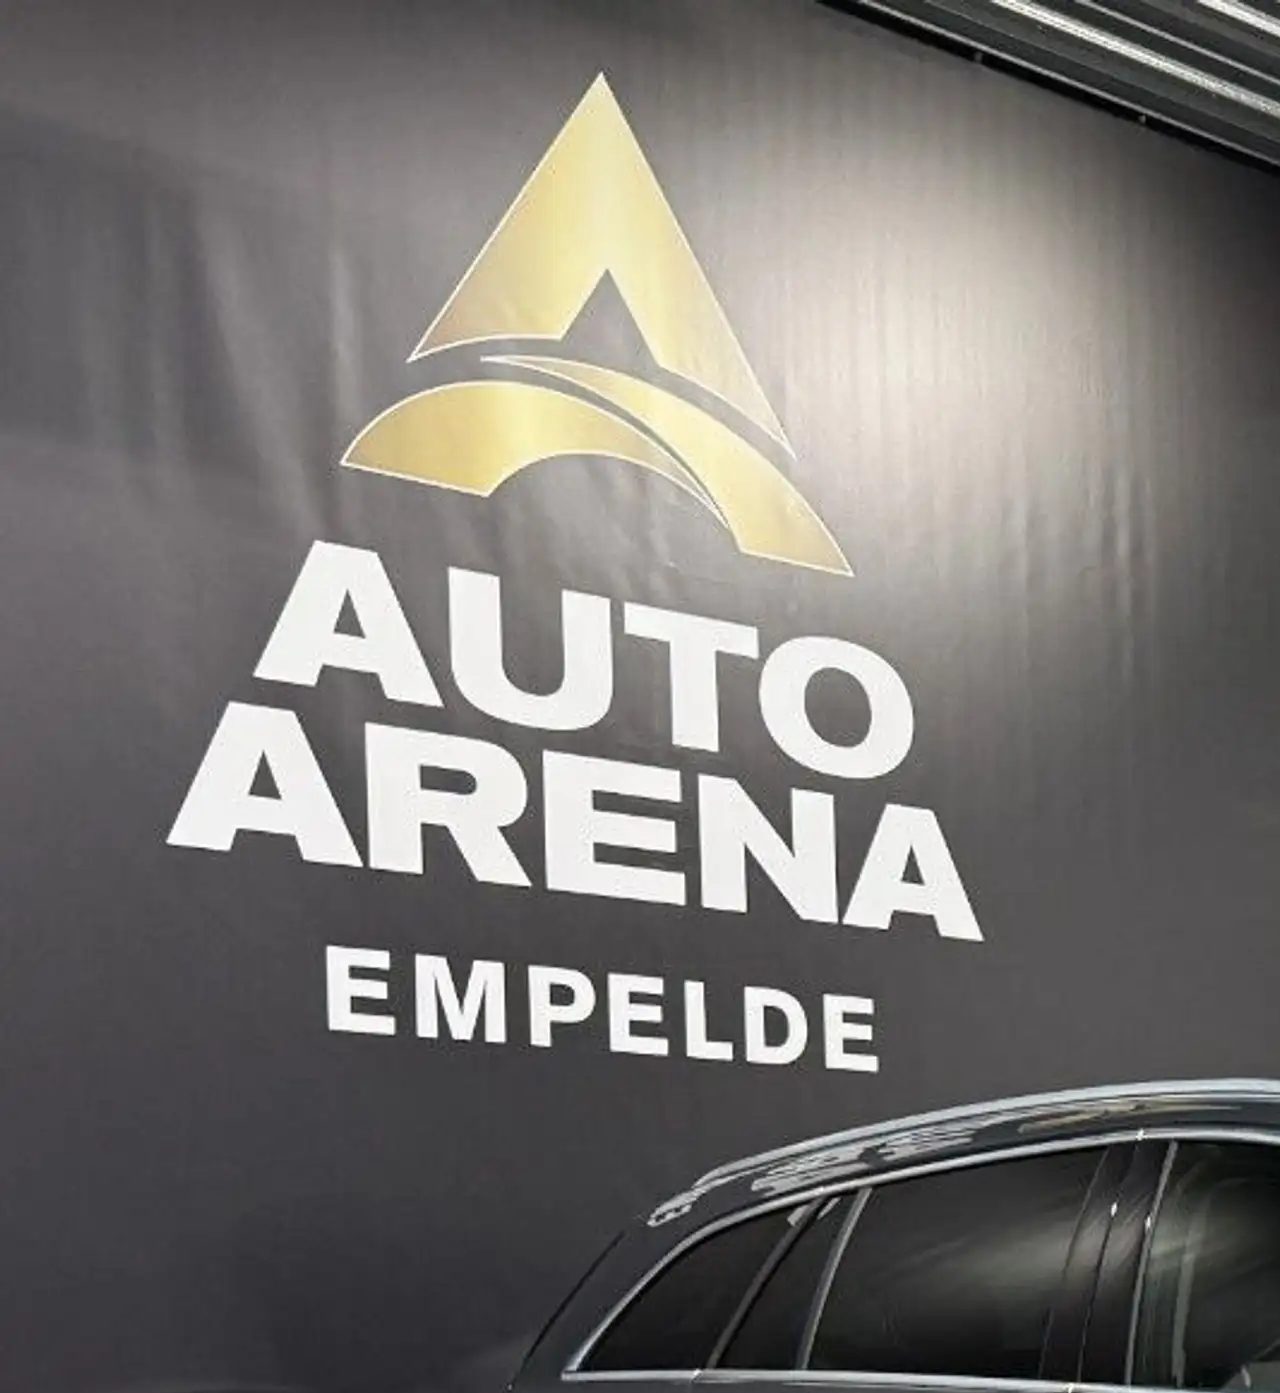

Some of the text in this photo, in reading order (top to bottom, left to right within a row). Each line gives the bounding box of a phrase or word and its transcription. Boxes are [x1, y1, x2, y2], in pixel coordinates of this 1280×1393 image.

[253, 540, 914, 779] AUTO
[166, 701, 985, 942] ARENA
[325, 945, 880, 1072] EMPELDE
